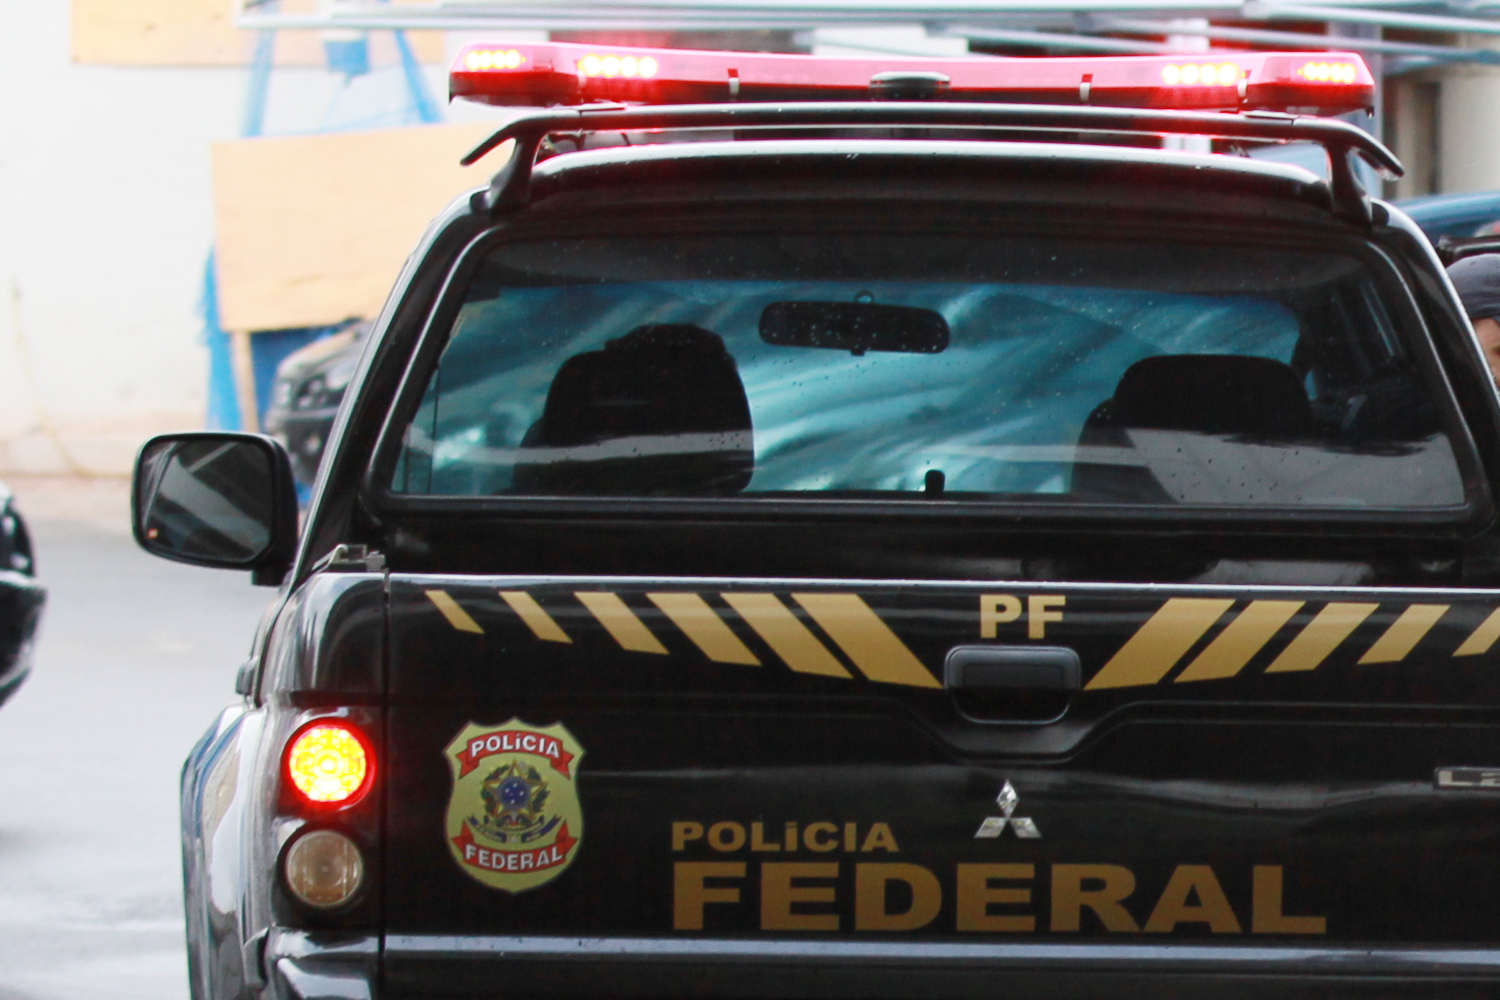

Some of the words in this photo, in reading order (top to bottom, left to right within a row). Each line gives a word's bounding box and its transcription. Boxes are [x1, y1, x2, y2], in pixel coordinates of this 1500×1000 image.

[979, 594, 1066, 639] PF
[465, 844, 563, 871] FEDERAL
[672, 861, 1327, 933] FEDERAL
